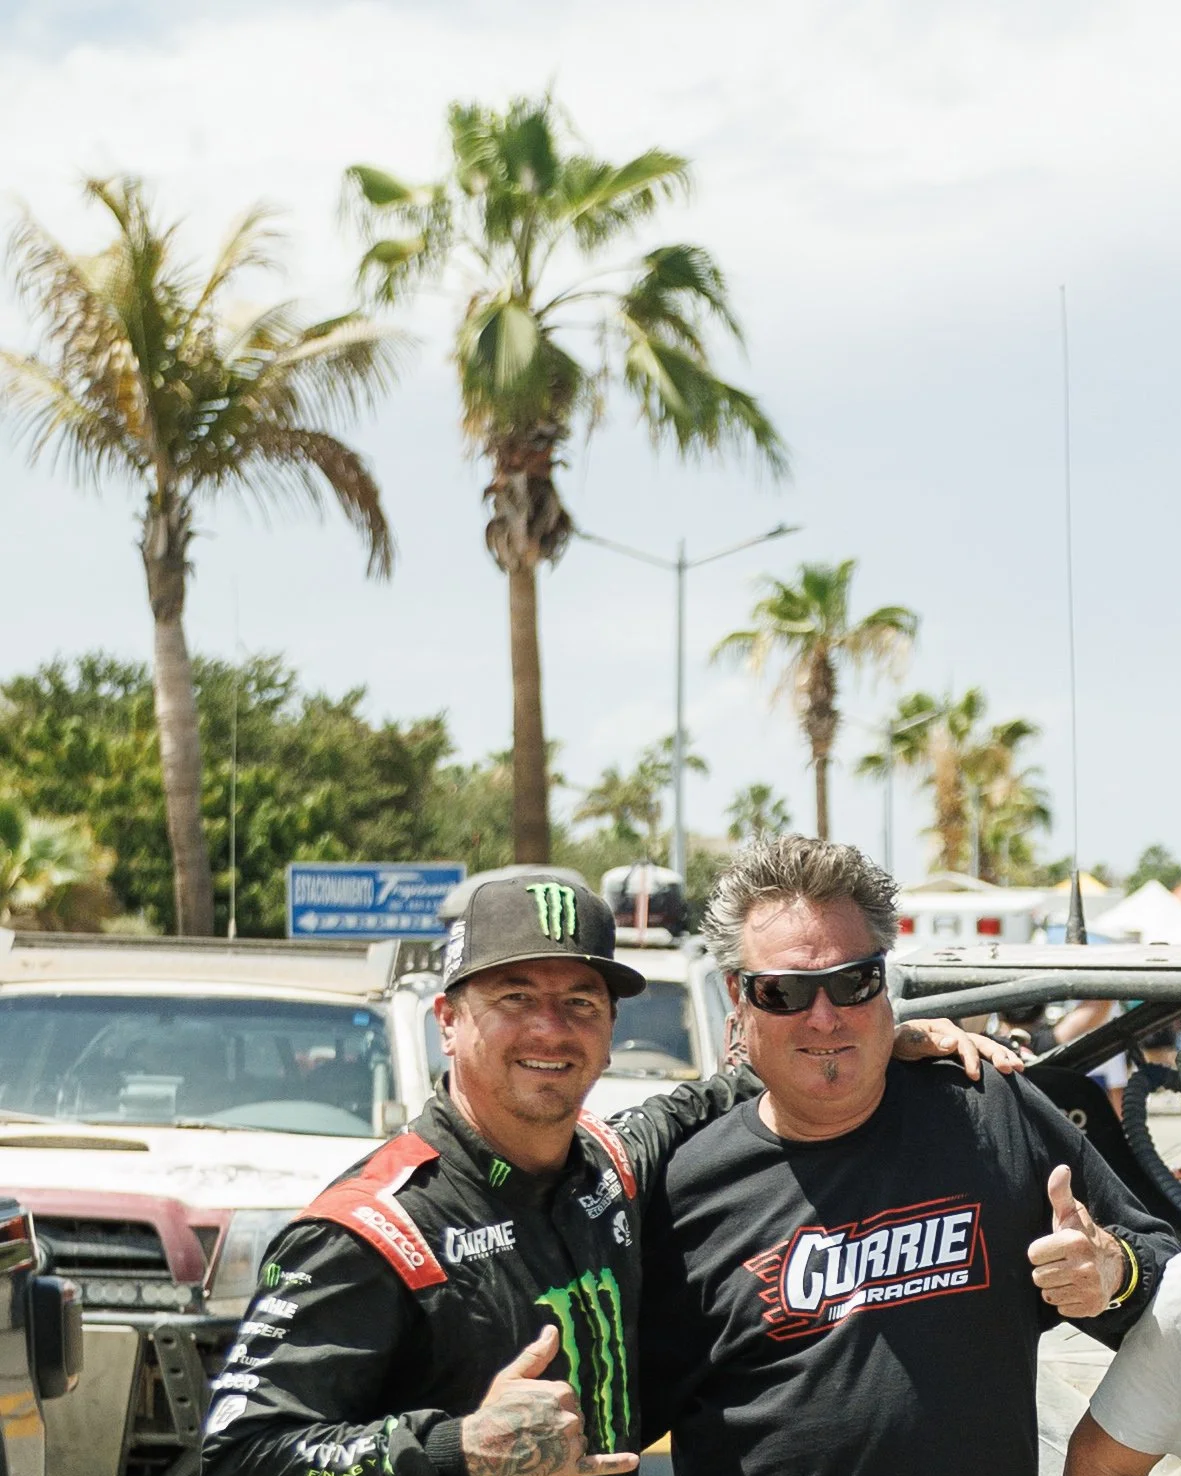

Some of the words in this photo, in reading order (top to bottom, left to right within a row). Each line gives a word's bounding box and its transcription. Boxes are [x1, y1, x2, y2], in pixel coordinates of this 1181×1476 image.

[352, 1206, 425, 1269] sparco
[787, 1211, 973, 1310] CURRIE
[865, 1270, 970, 1303] RACING
